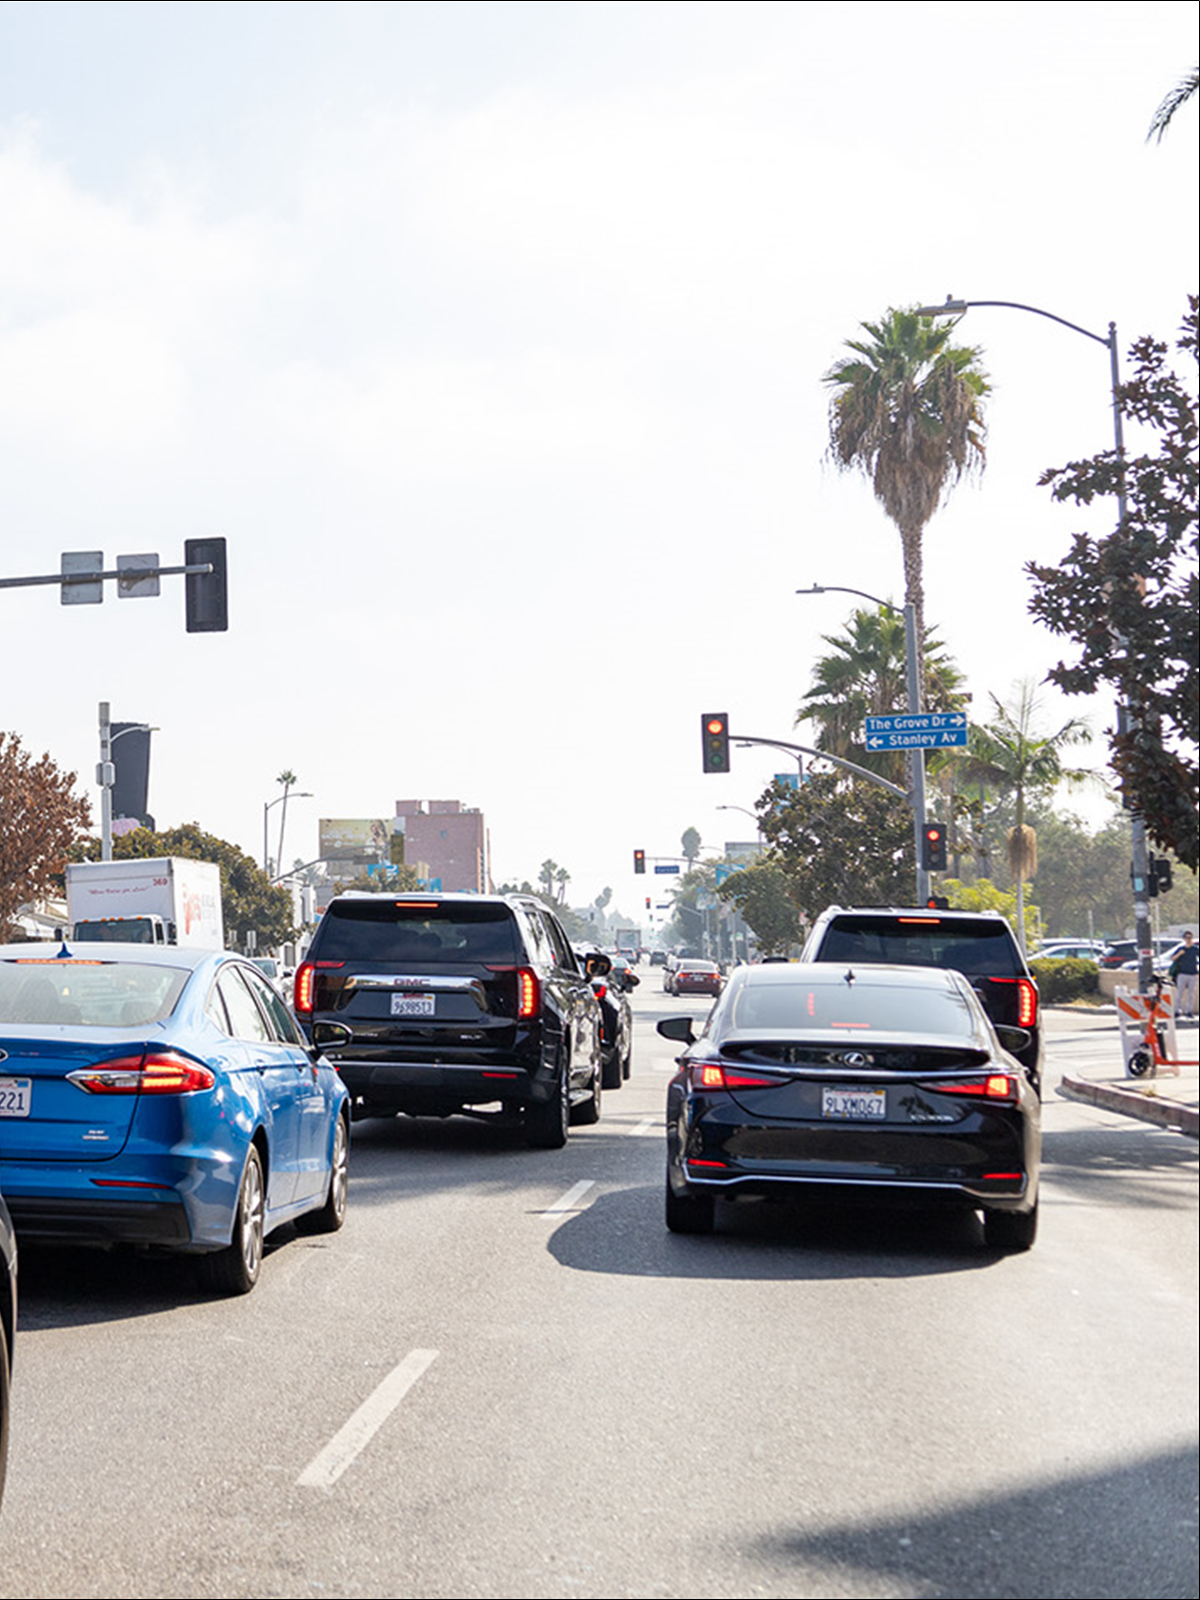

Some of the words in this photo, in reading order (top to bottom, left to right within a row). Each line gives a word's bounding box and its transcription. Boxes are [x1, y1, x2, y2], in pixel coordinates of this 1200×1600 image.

[869, 719, 891, 730] The
[894, 718, 929, 729] Grove
[932, 716, 947, 727] Dr
[889, 734, 936, 746] Stanley
[941, 732, 957, 743] Av
[152, 878, 168, 887] 369
[393, 978, 431, 986] GMC
[825, 1096, 883, 1114] 9LXM067
